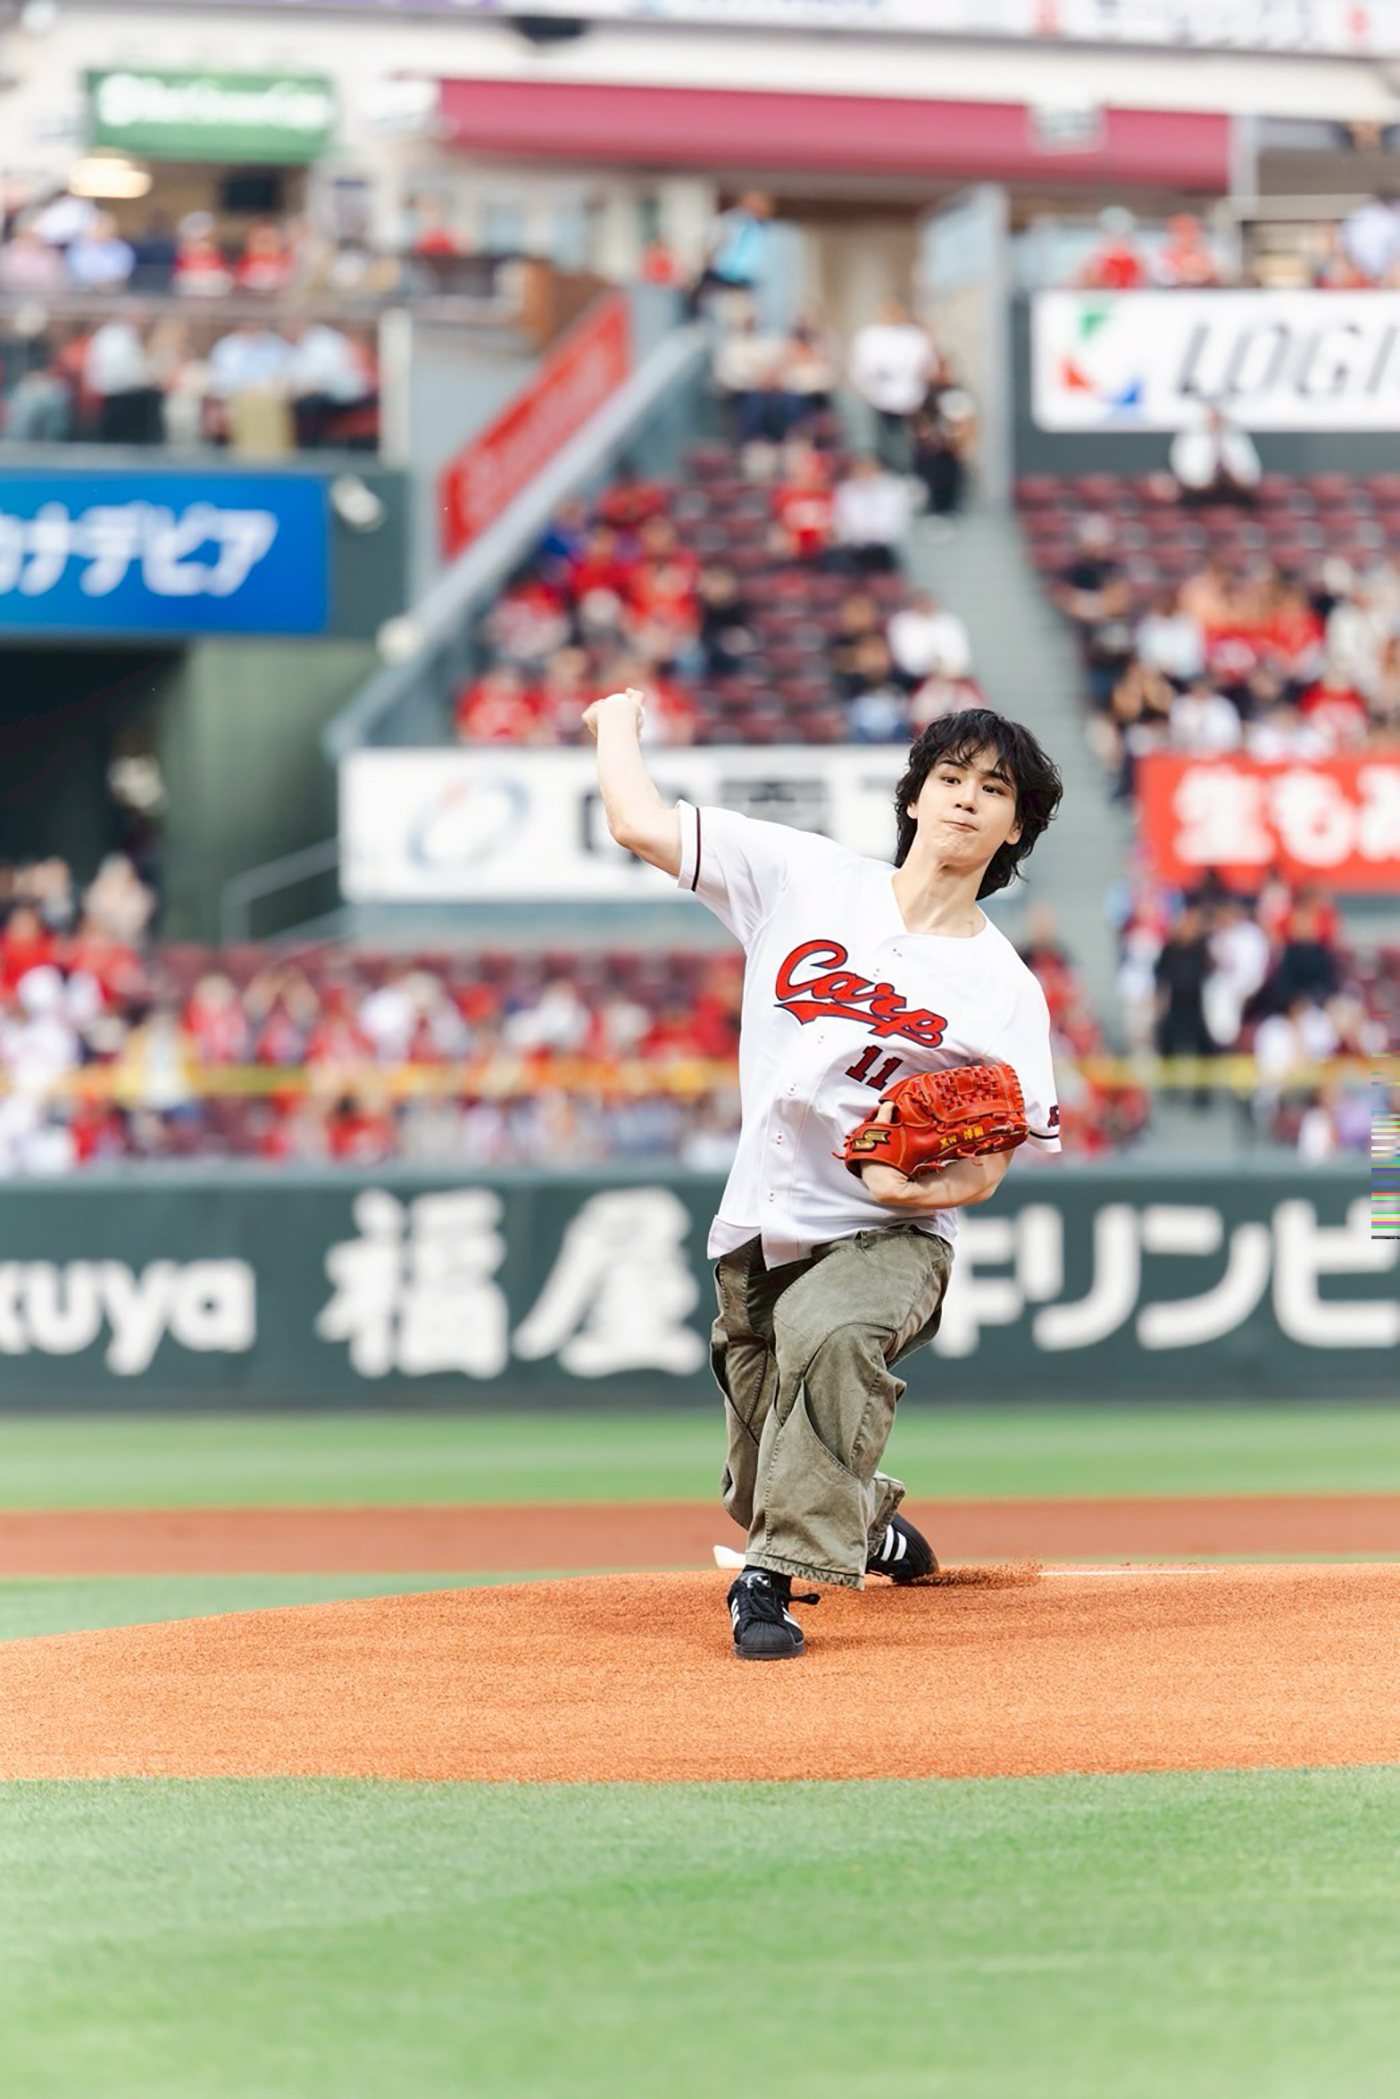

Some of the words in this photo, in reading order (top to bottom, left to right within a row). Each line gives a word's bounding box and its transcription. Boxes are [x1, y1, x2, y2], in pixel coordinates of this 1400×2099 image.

[1174, 318, 1399, 400] LOGI
[773, 939, 948, 1048] Carp
[845, 1045, 903, 1091] 11
[315, 1188, 706, 1378] 福屋
